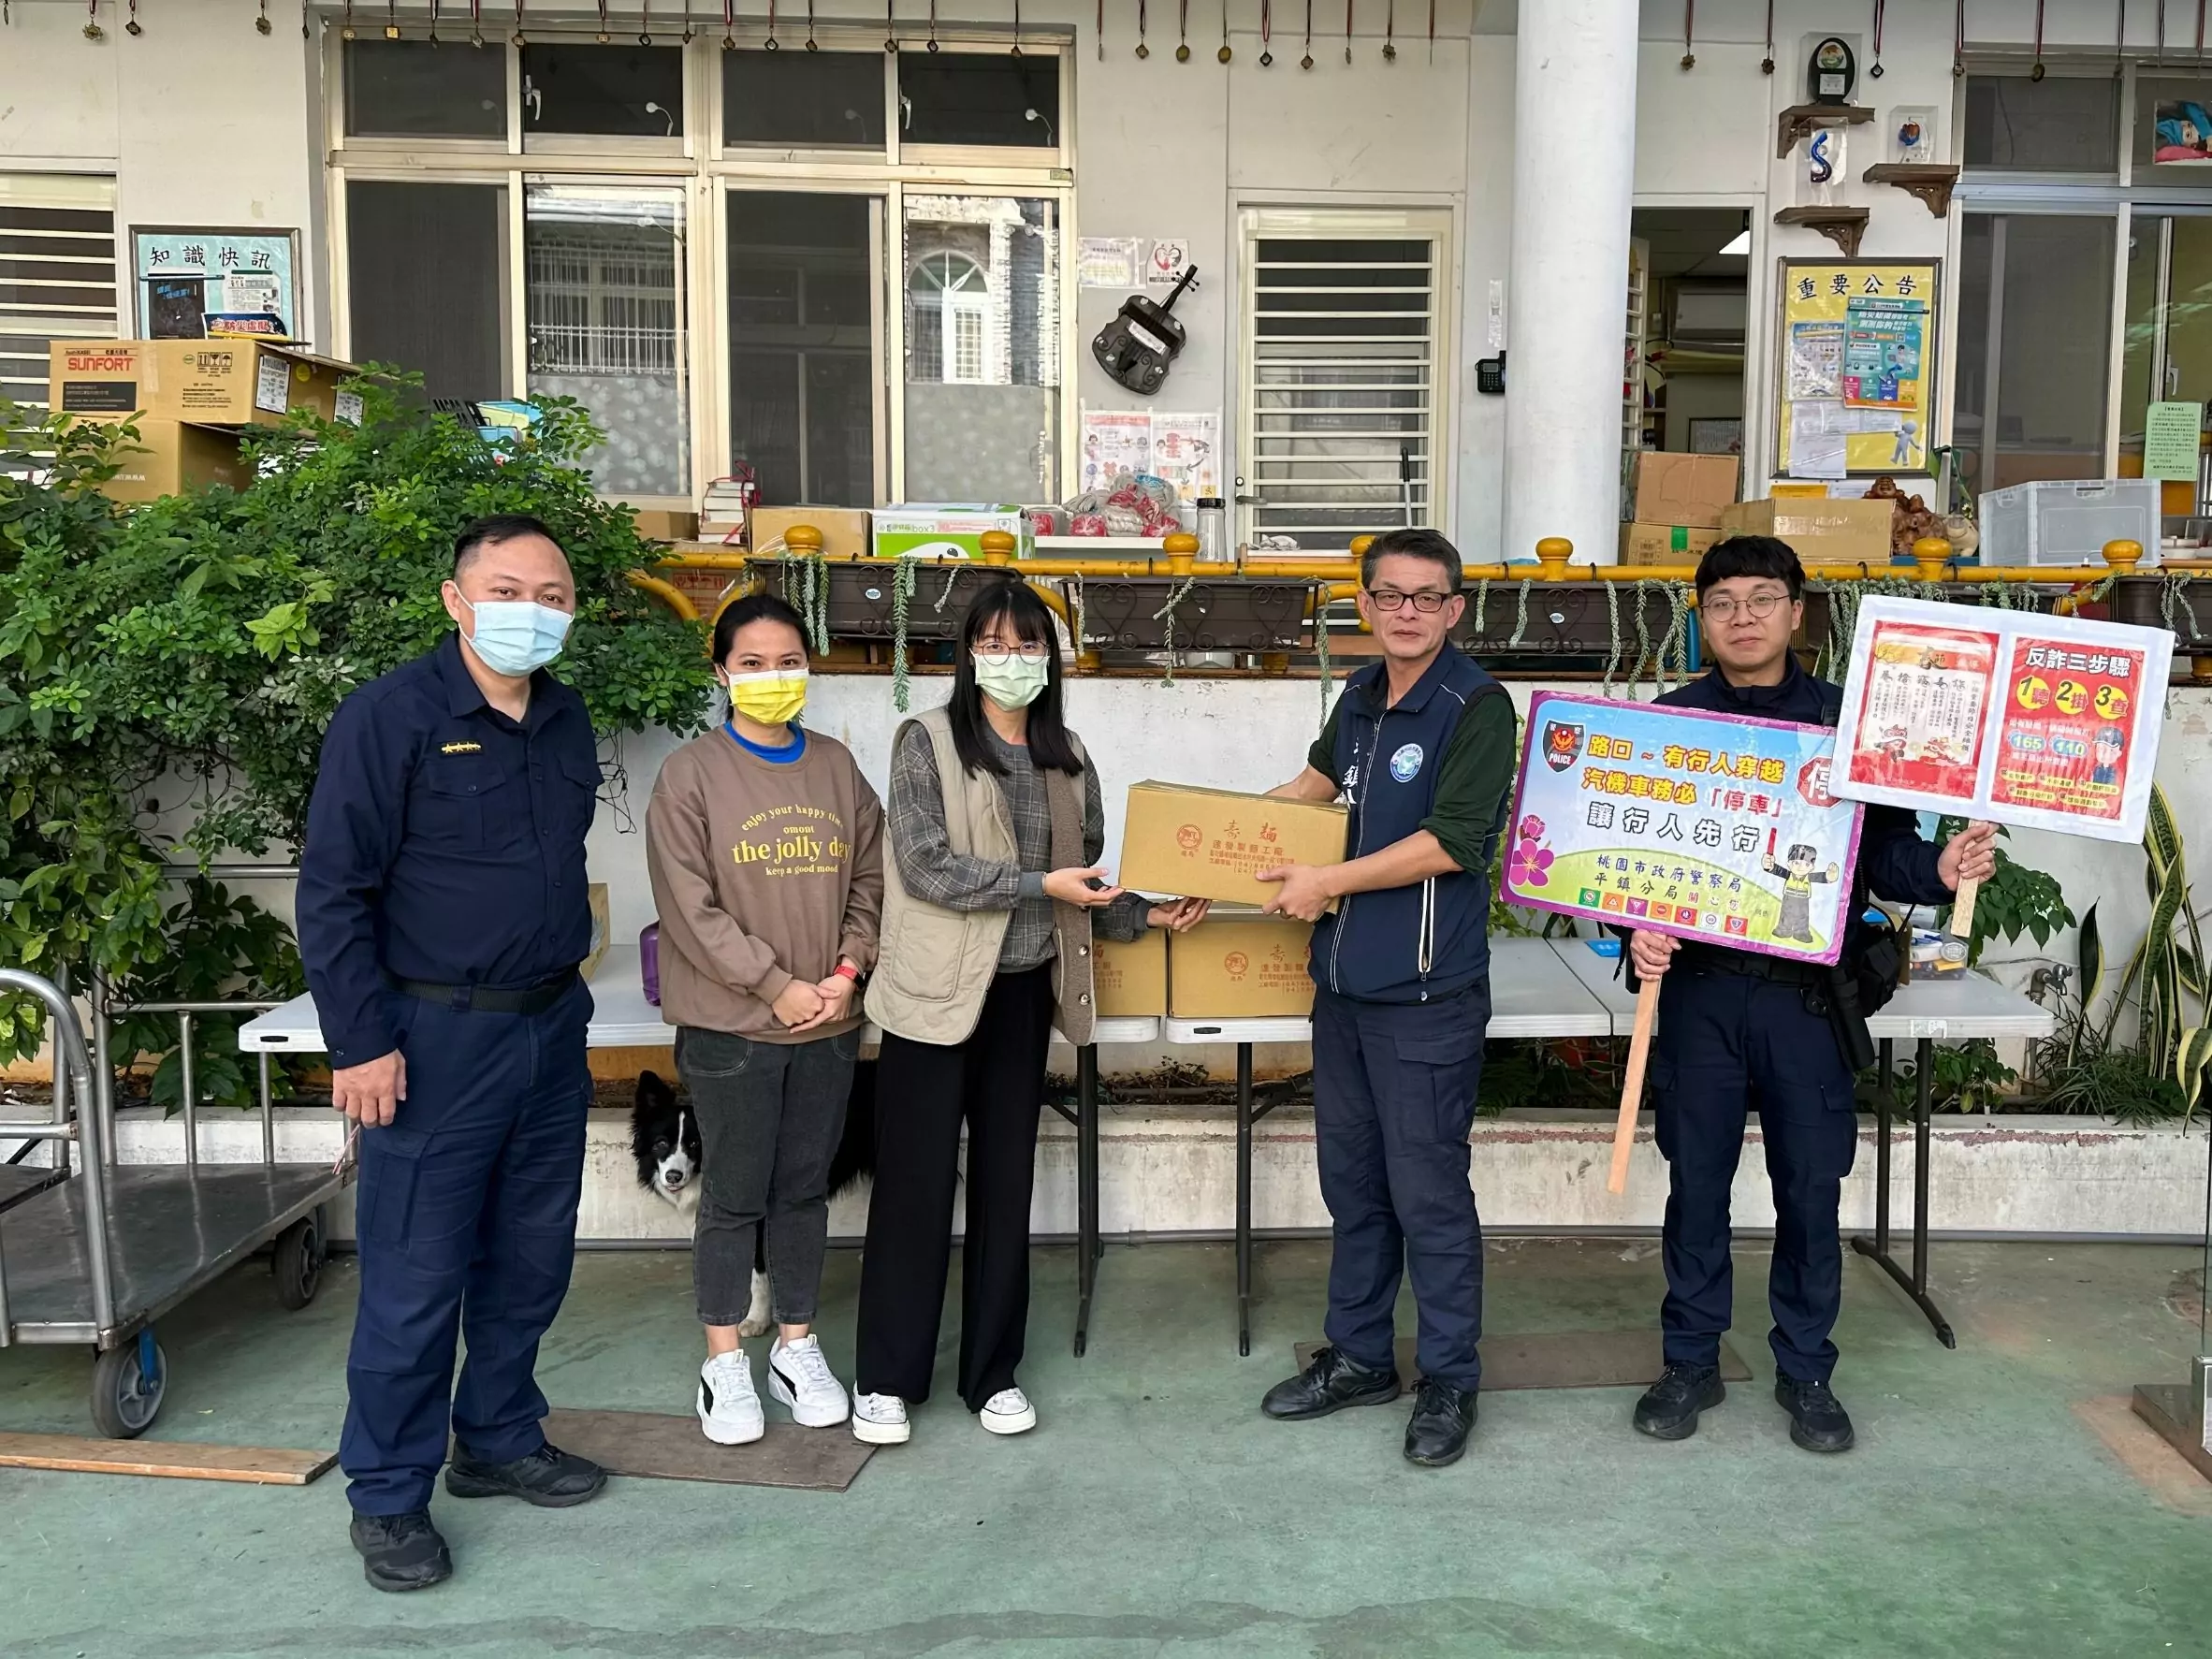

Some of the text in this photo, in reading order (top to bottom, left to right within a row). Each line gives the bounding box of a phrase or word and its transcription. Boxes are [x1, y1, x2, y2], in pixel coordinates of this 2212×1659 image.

[150, 245, 270, 269] 知識快訊
[1797, 273, 1917, 300] 重要公告
[68, 357, 133, 371] SUNFORT
[912, 524, 935, 532] box3
[2025, 648, 2132, 678] 反詐三步驟
[1549, 752, 1572, 764] POLICE
[2015, 735, 2085, 755] 165 110
[1586, 735, 1634, 762] 路口
[1663, 745, 1786, 784] 有行人穿越
[1582, 767, 1698, 805] 汽機車務必
[742, 812, 767, 831] enjoy
[768, 806, 793, 819] your
[795, 804, 825, 819] happy
[1587, 802, 1761, 852] 讓行人先行
[731, 836, 851, 864] the jolly day
[765, 867, 785, 877] keep
[794, 865, 814, 875] good
[817, 865, 838, 873] mood
[1596, 853, 1742, 894] 桃園市政府警察局
